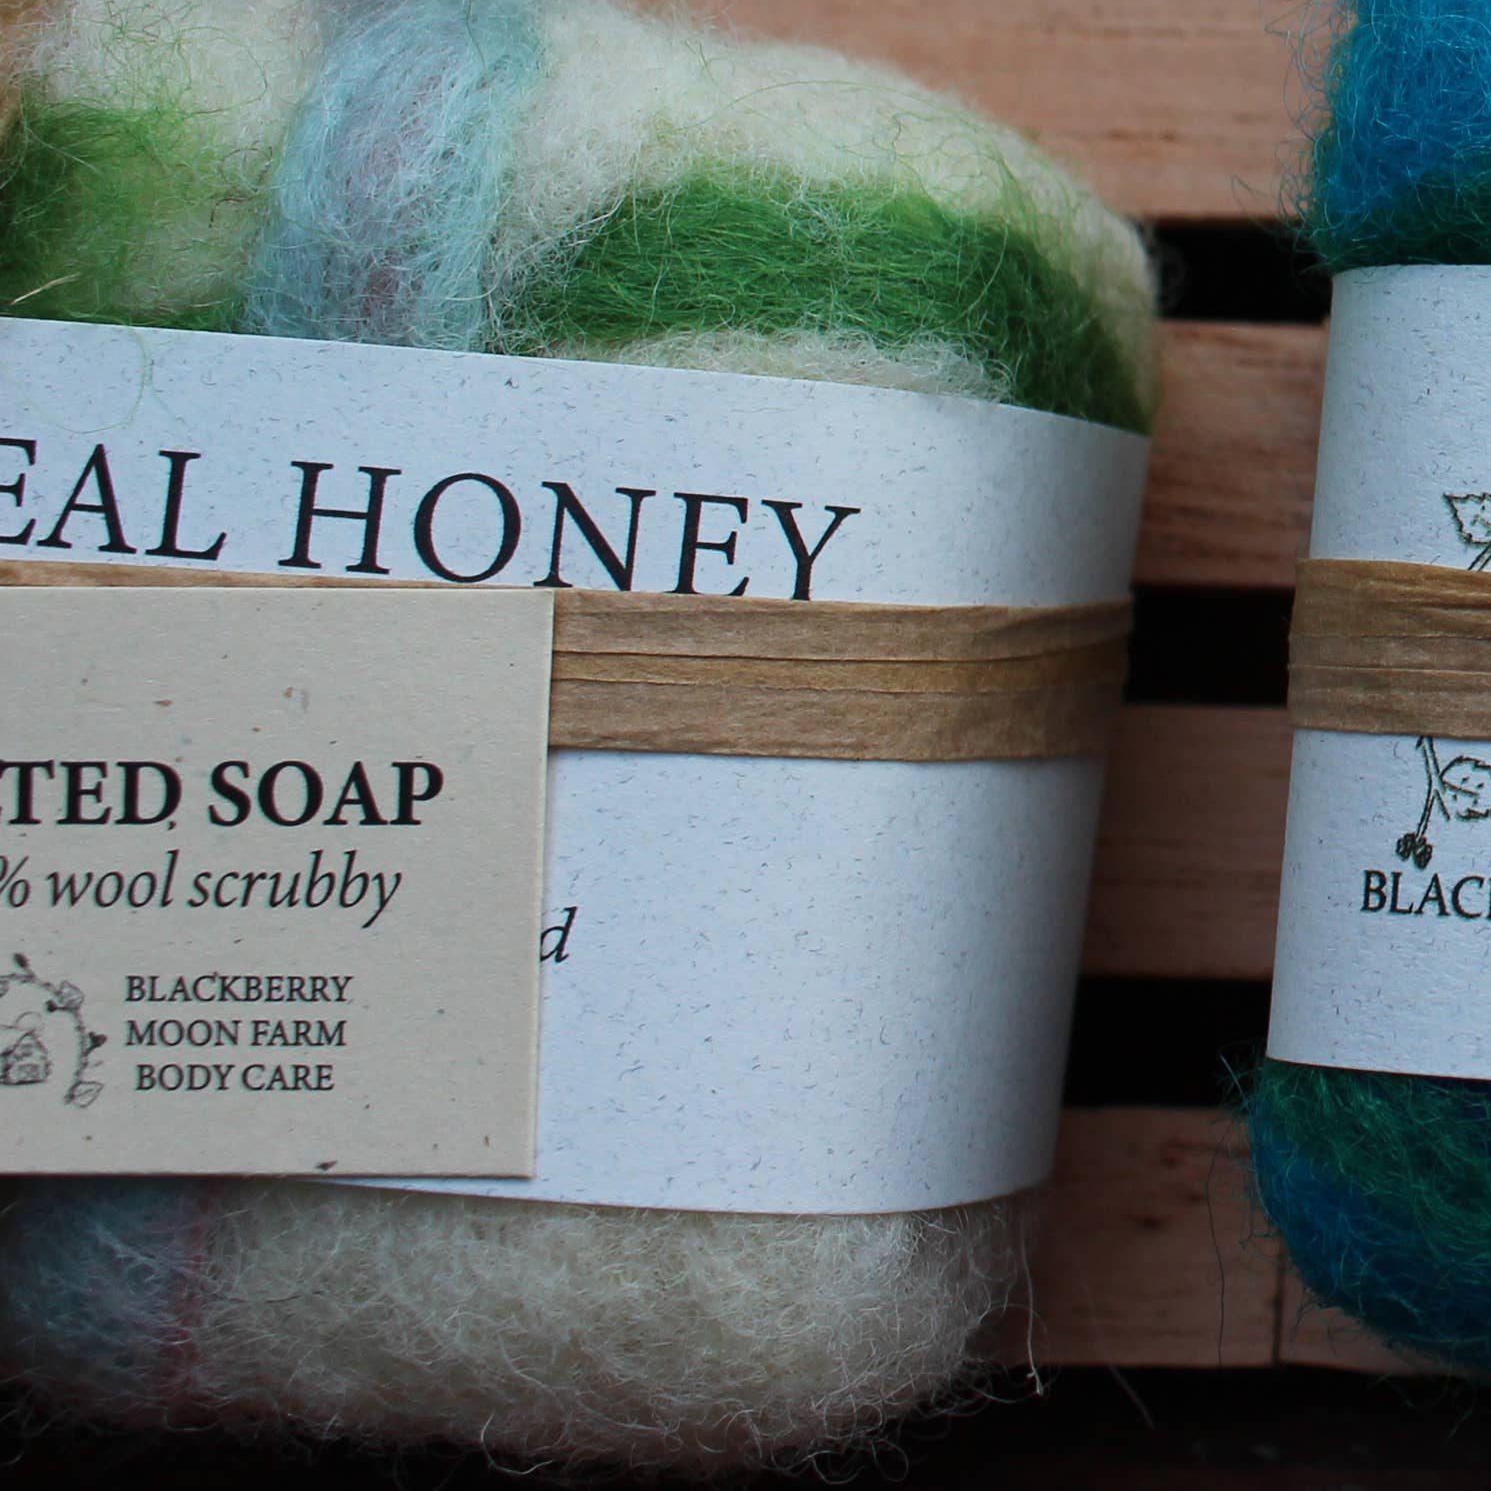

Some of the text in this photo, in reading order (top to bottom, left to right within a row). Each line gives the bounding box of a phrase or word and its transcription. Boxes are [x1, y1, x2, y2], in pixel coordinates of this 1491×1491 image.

[278, 460, 861, 601] HONEY
[208, 759, 445, 827] SOAP
[46, 849, 180, 908] wool
[187, 849, 402, 929] scrubby
[124, 973, 353, 1003] BLACKBERRY
[124, 1019, 347, 1048] MOON FARM
[135, 1063, 336, 1092] BODY CARE
